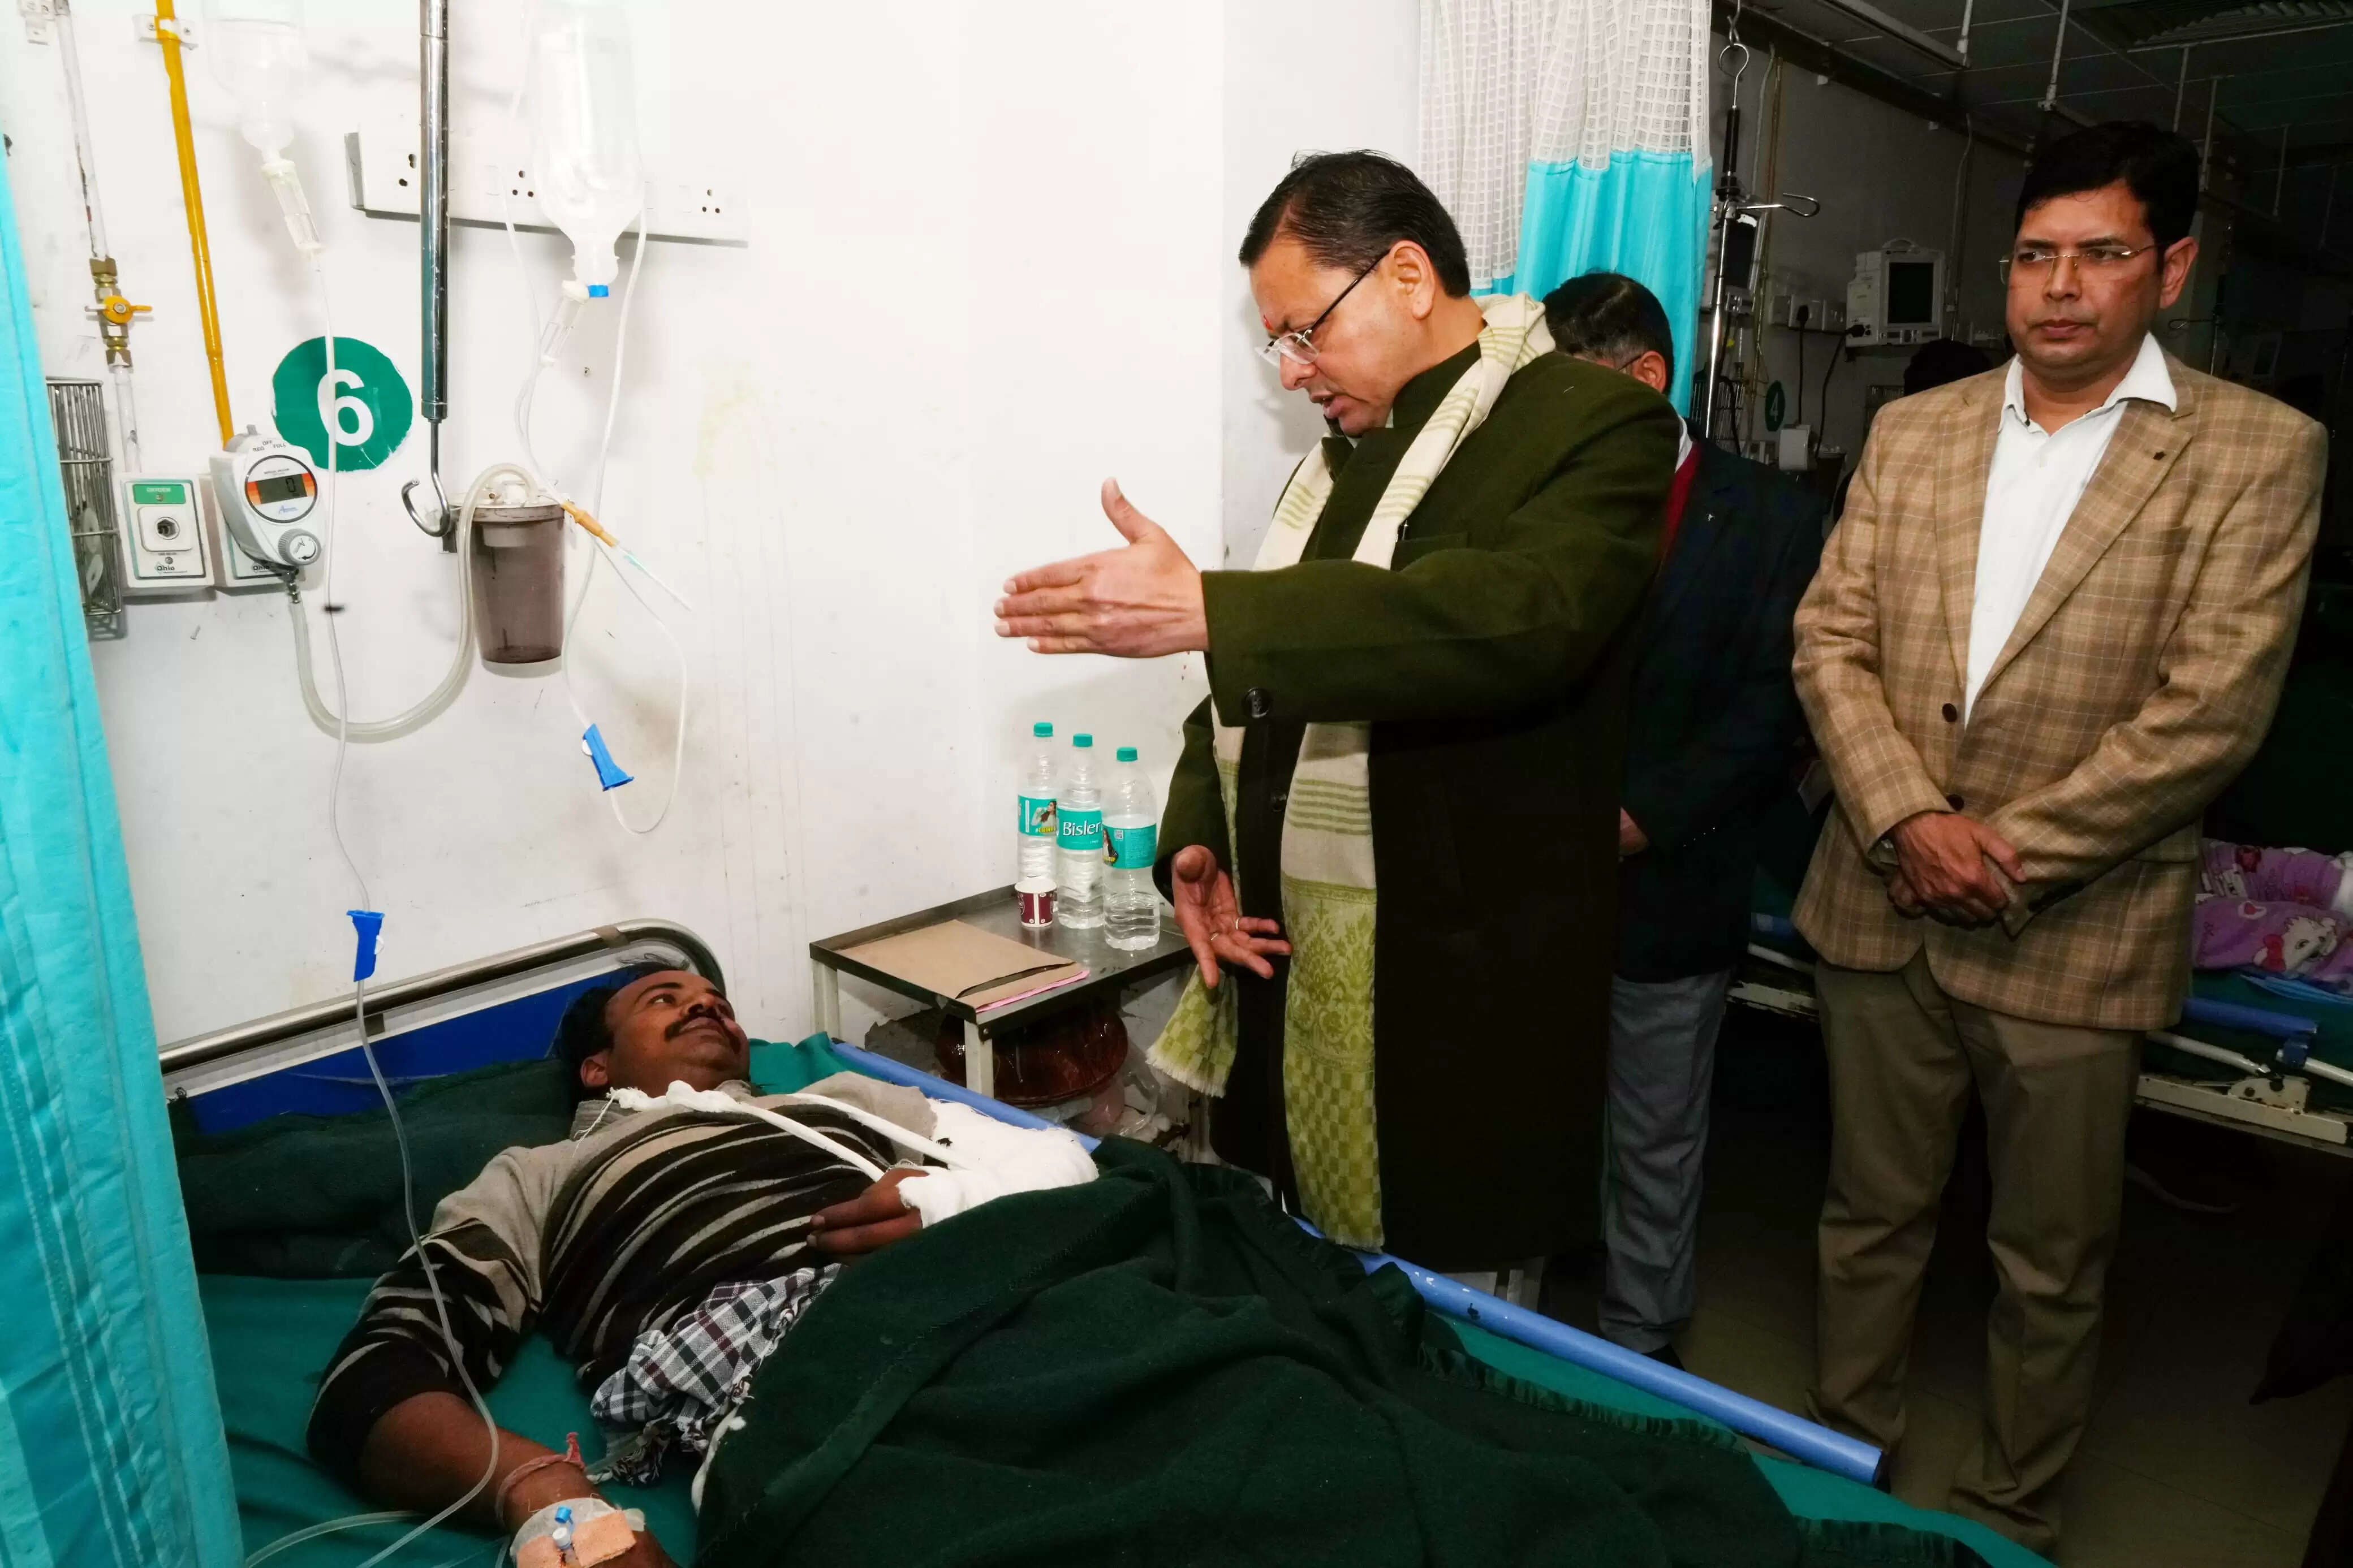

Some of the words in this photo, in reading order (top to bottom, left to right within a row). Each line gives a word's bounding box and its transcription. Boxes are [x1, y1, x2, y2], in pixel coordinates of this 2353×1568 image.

[317, 369, 374, 447] 6
[1770, 392, 1779, 422] 4
[286, 477, 296, 493] 0
[1063, 819, 1102, 836] Bisler
